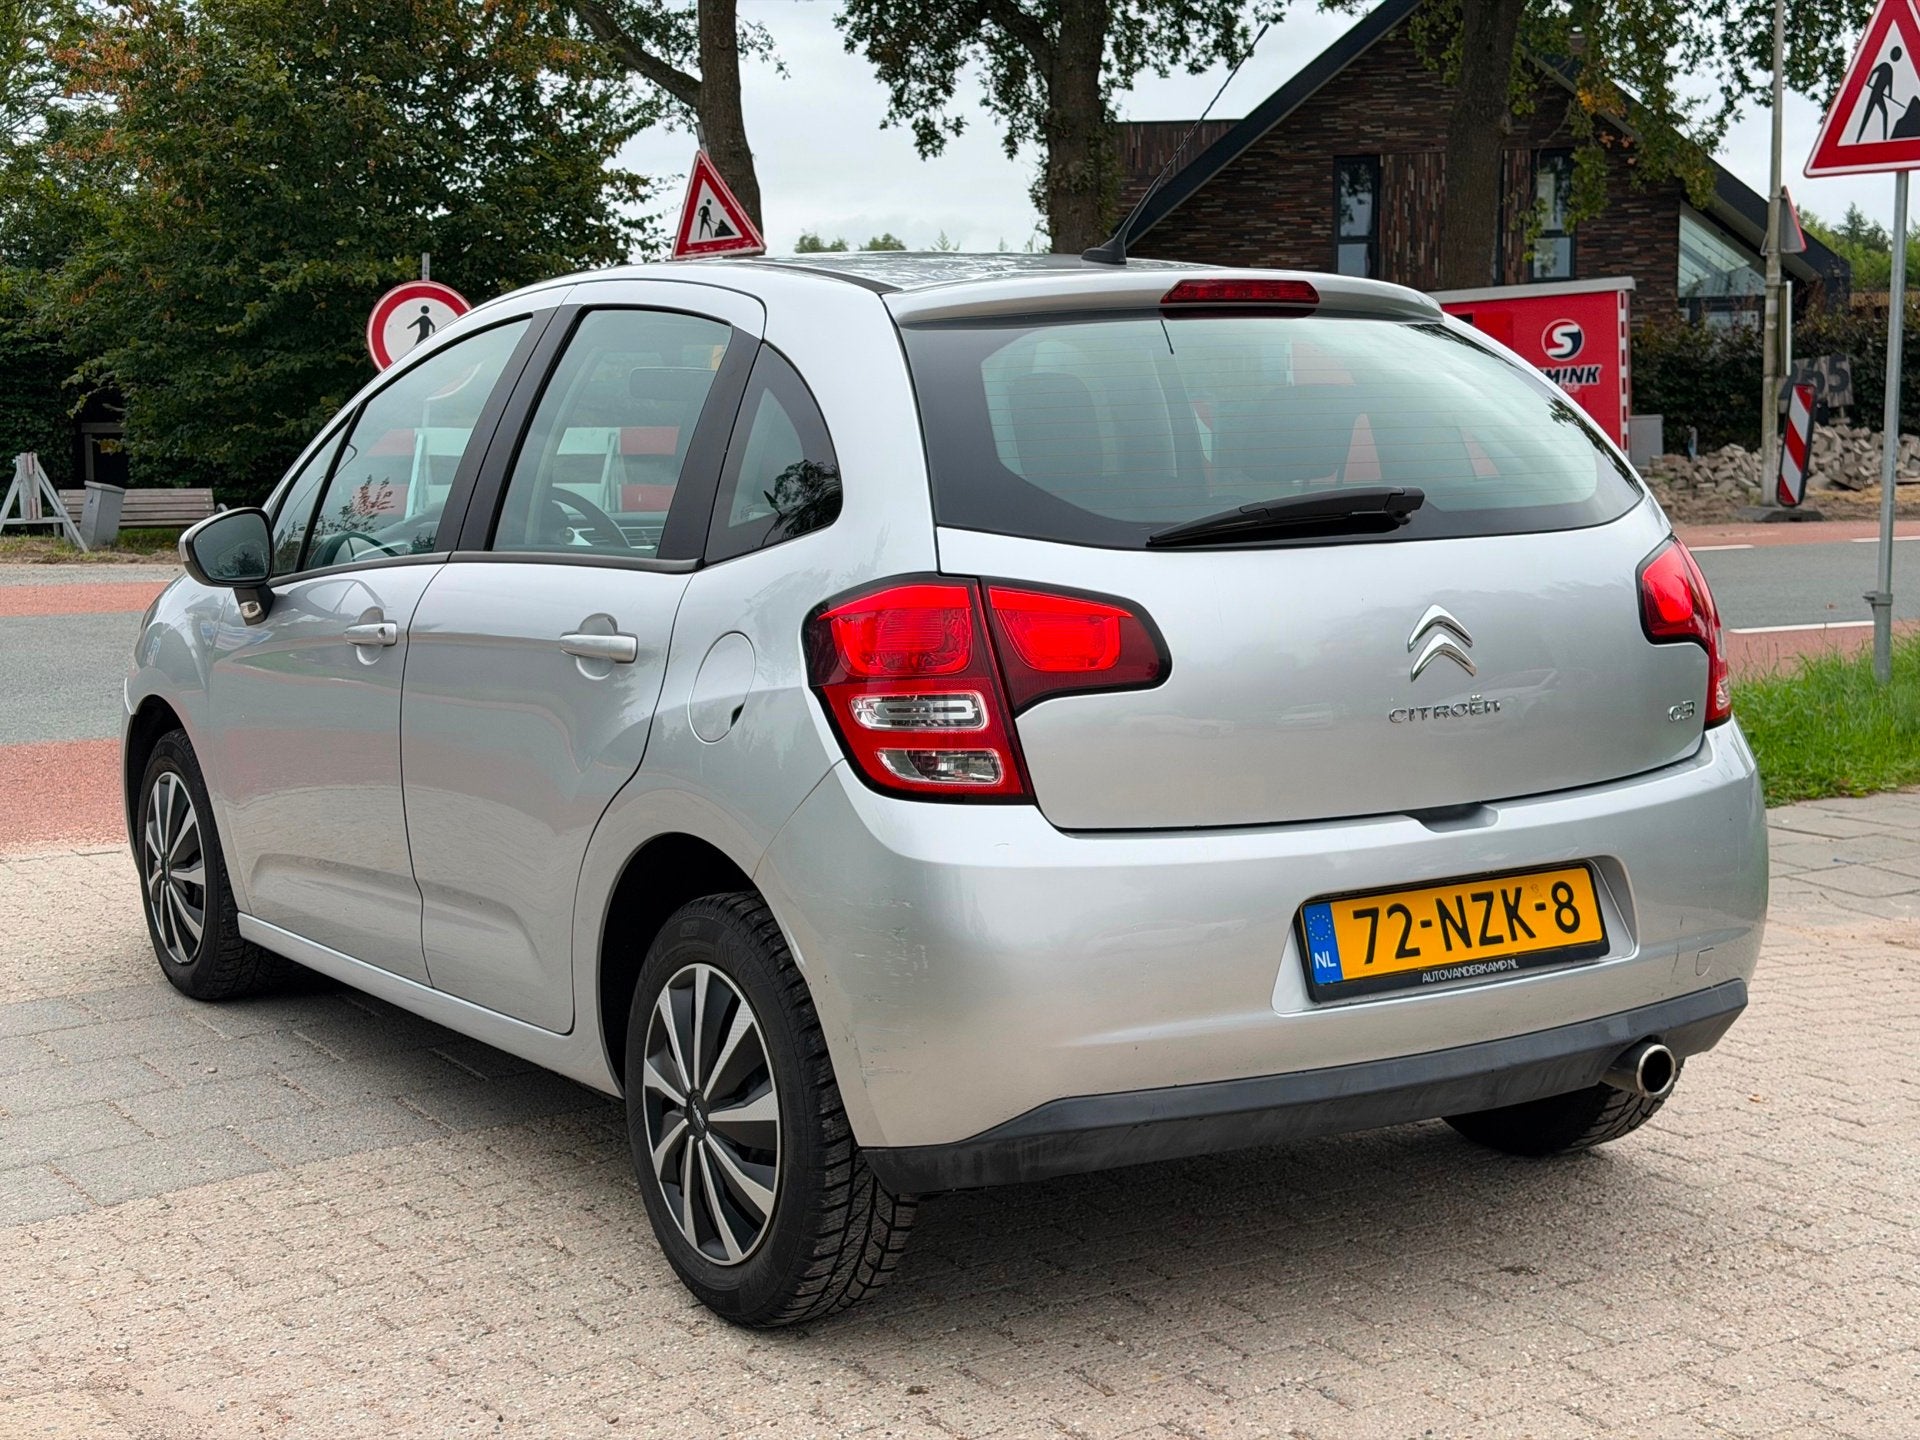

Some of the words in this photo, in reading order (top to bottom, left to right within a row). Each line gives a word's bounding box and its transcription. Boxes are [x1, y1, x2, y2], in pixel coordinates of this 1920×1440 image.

[1547, 325, 1580, 355] S
[1540, 366, 1600, 384] MINK
[1668, 700, 1695, 721] C3
[1352, 880, 1581, 965] 72-NZK-8
[1314, 950, 1337, 969] NL
